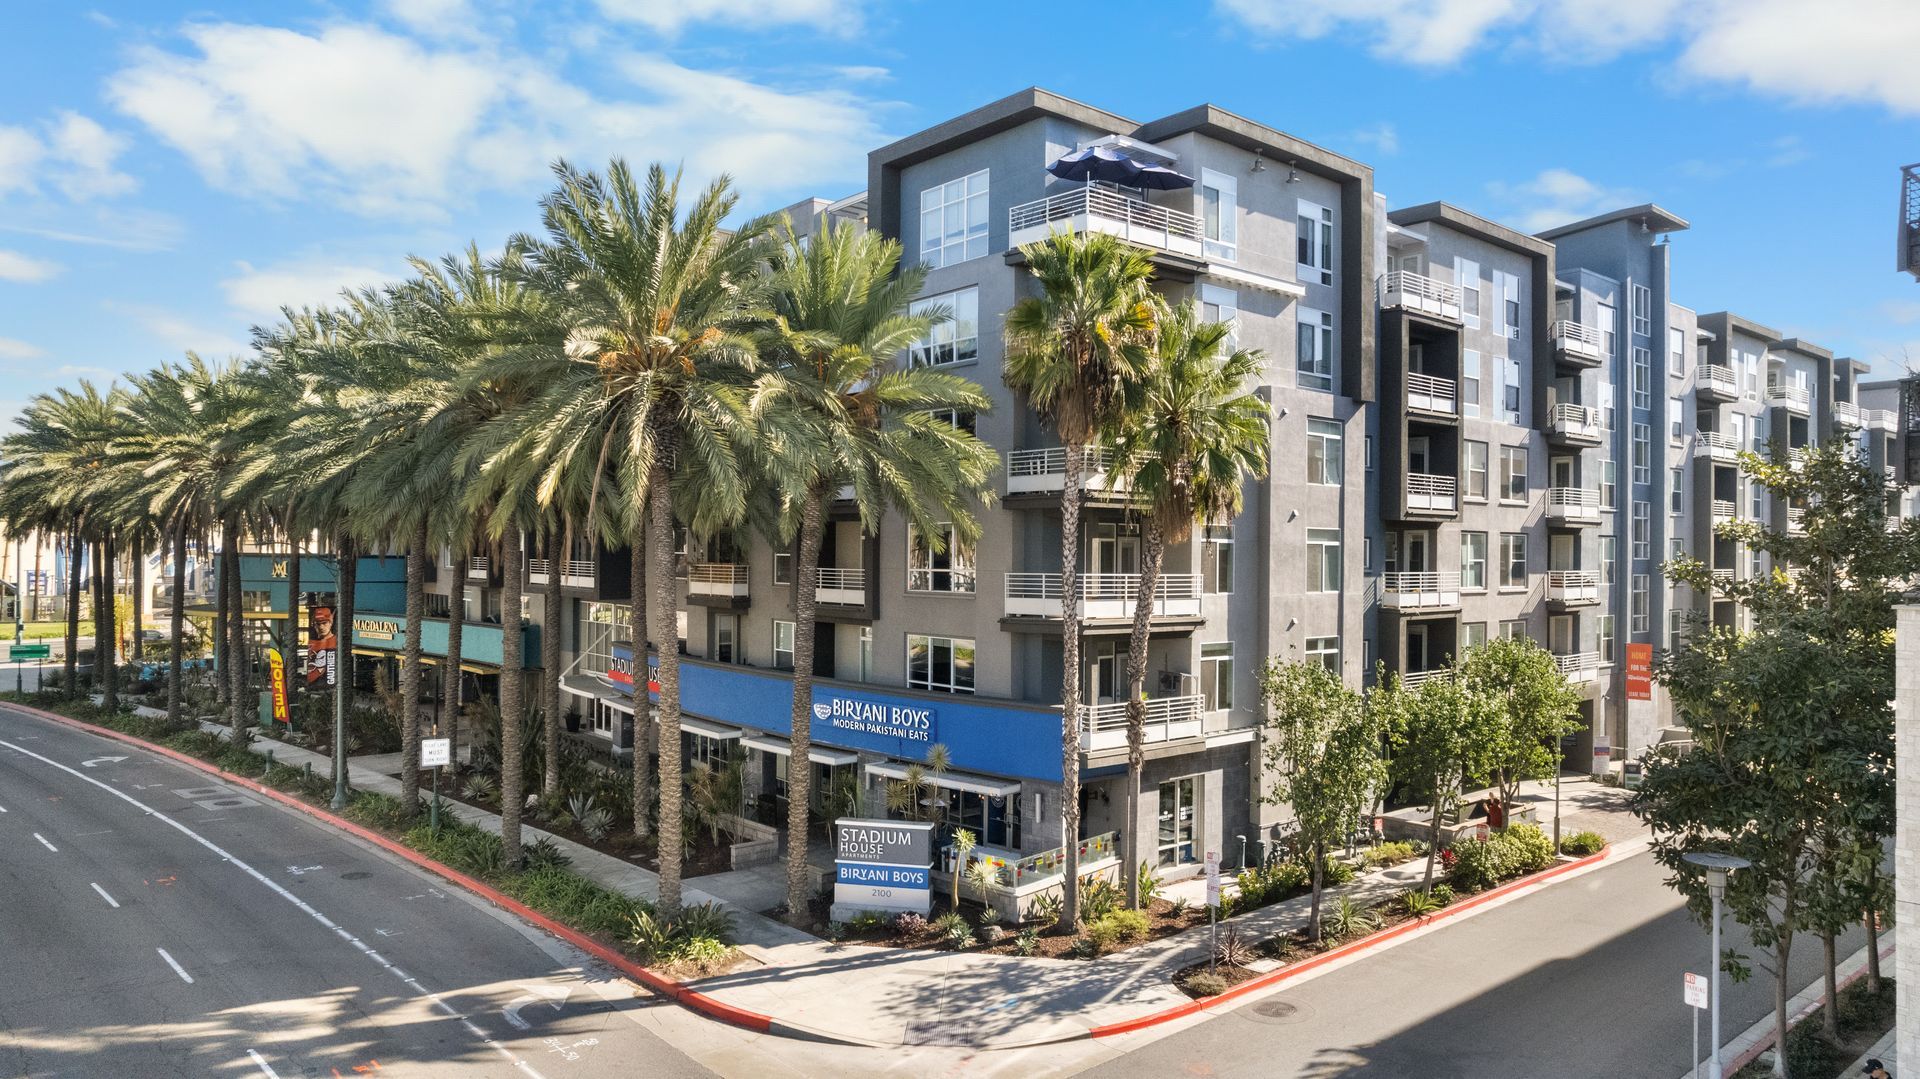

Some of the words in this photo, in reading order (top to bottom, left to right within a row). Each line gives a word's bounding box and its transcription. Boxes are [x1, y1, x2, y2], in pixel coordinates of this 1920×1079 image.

[353, 619, 398, 634] MAGDALENA
[327, 650, 336, 685] GAUTHIER
[833, 699, 887, 723] BIRYANI
[892, 707, 930, 729] BOYS
[833, 718, 865, 731] MODERN
[866, 723, 907, 738] PAKISTANI
[909, 730, 929, 741] EATS
[841, 828, 911, 846] STADIUM
[840, 842, 884, 855] HOUSE
[840, 867, 888, 881] BIRYANI
[893, 871, 924, 884] BOYS
[871, 888, 892, 898] 2100
[1686, 974, 1695, 984] NO
